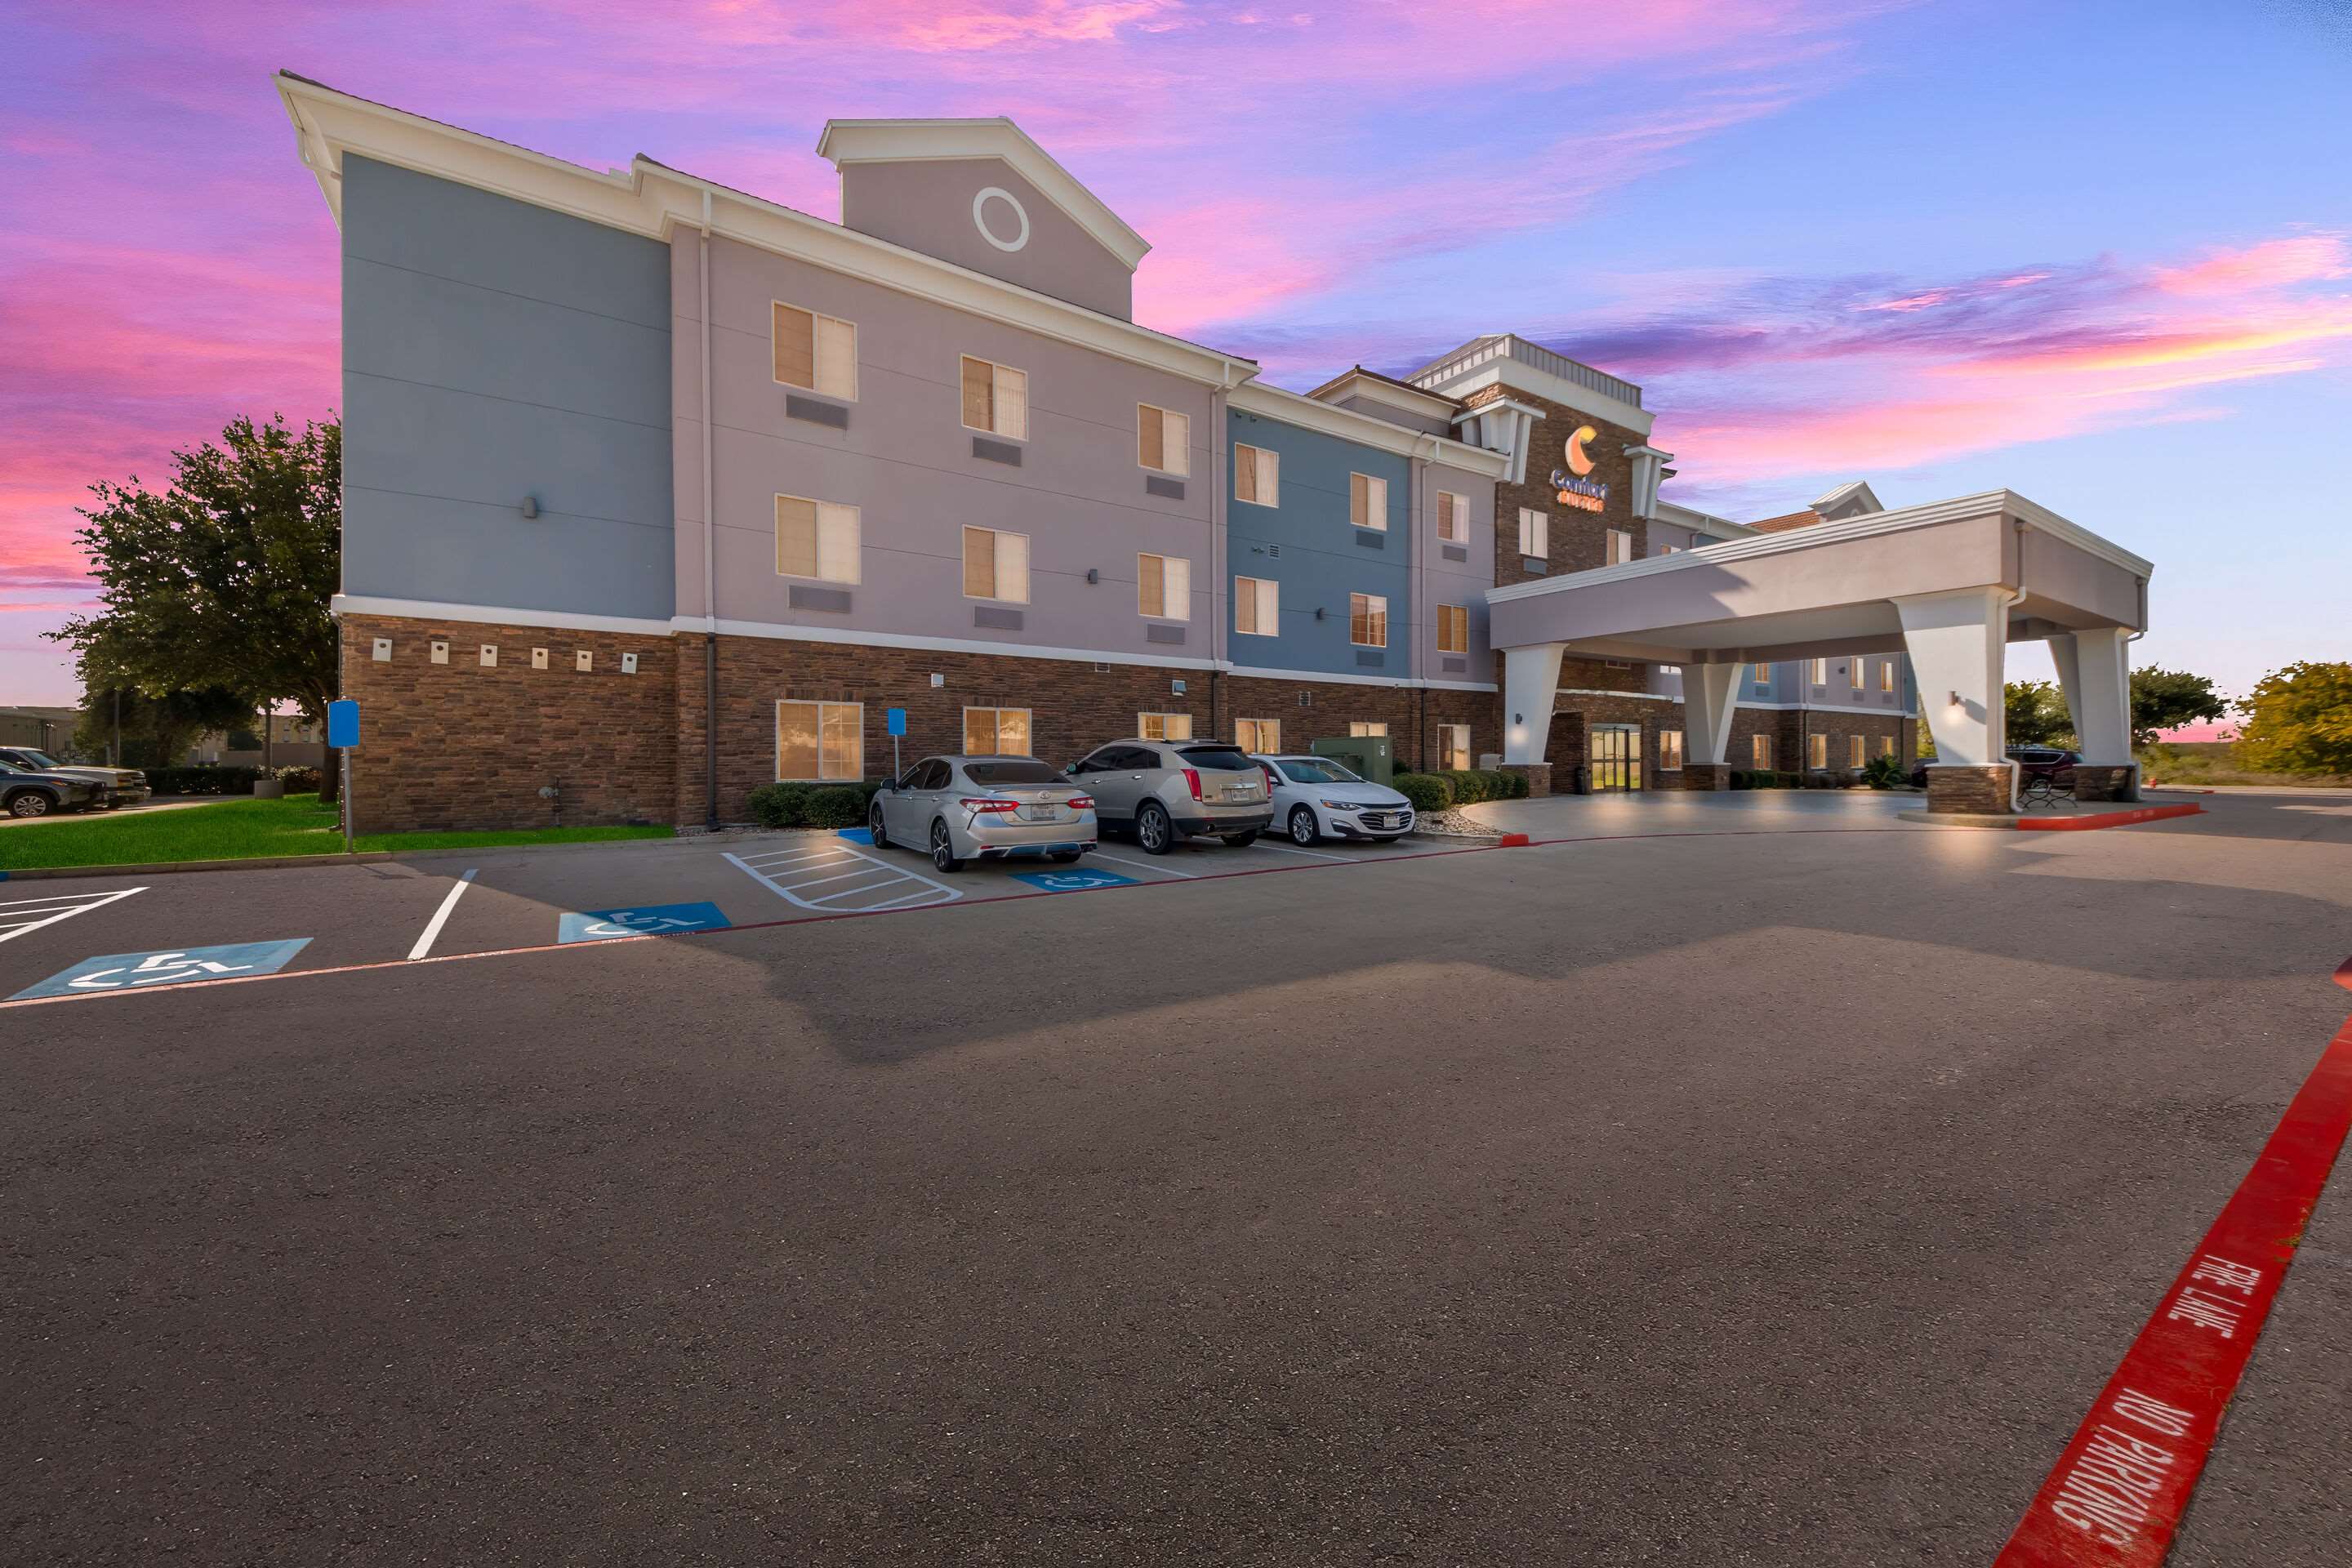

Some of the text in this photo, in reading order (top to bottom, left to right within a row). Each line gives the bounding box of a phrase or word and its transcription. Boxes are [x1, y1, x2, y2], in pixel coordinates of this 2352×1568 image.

[2167, 1254, 2261, 1339] FIRE LANE
[2052, 1388, 2195, 1545] NO PARKING
